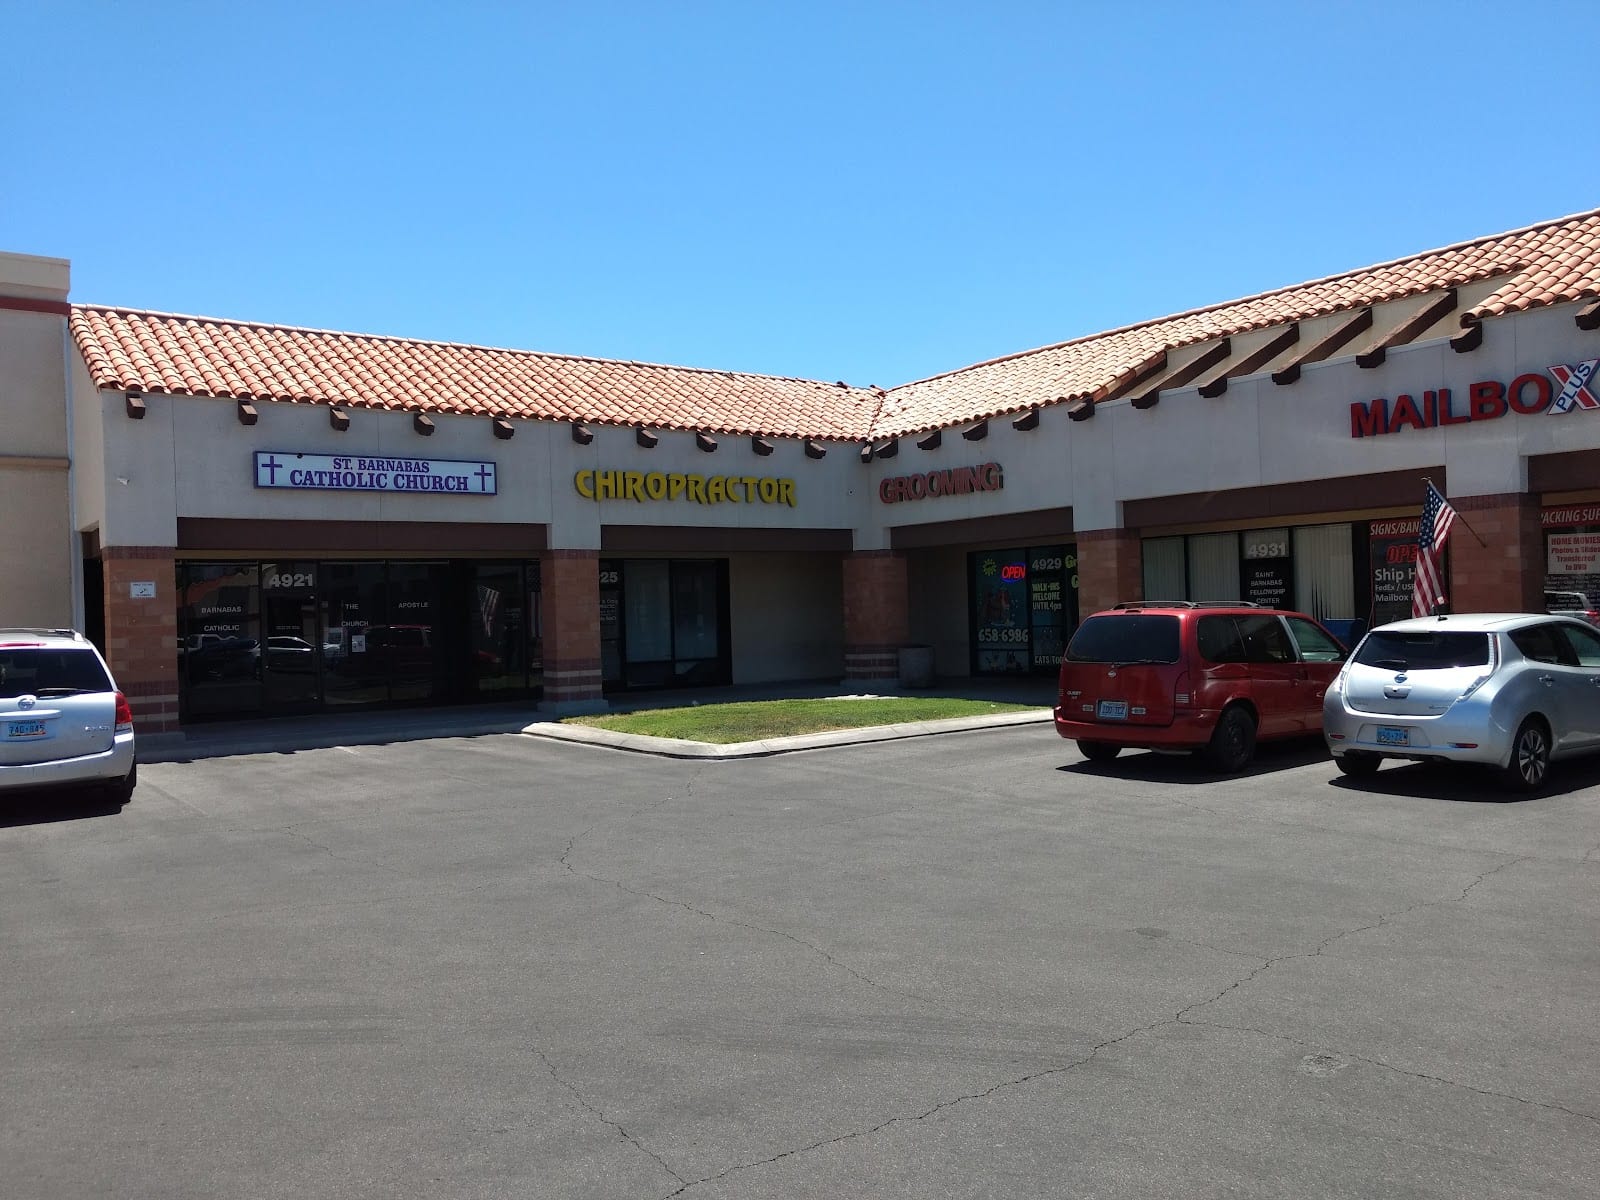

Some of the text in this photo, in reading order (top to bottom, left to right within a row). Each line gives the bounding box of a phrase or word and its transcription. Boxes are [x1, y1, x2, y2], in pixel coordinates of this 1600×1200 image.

[1556, 363, 1592, 411] PLUS
[1350, 359, 1600, 438] MAILBOX
[333, 457, 430, 473] ST. BARNABAS
[289, 470, 469, 491] CATHOLIC CHURCH
[879, 462, 1004, 504] GROOMING
[575, 469, 797, 507] CHIROPRACTOR
[1541, 510, 1581, 524] ACKING
[1248, 542, 1286, 559] 4931
[1386, 544, 1419, 564] OPE
[1032, 558, 1062, 570] 4929
[600, 571, 618, 584] 25
[1002, 565, 1026, 579] OPEN
[1374, 567, 1404, 583] Ship
[269, 573, 313, 588] 4921
[1032, 592, 1061, 601] WELCOME
[1249, 588, 1285, 596] FELLOWSHIP
[1375, 593, 1409, 602] Mailbox
[201, 606, 242, 614] BARNABAS
[1032, 601, 1049, 610] UNTIL
[203, 624, 240, 632] CATHOLIC
[978, 628, 1029, 642] 658-6986
